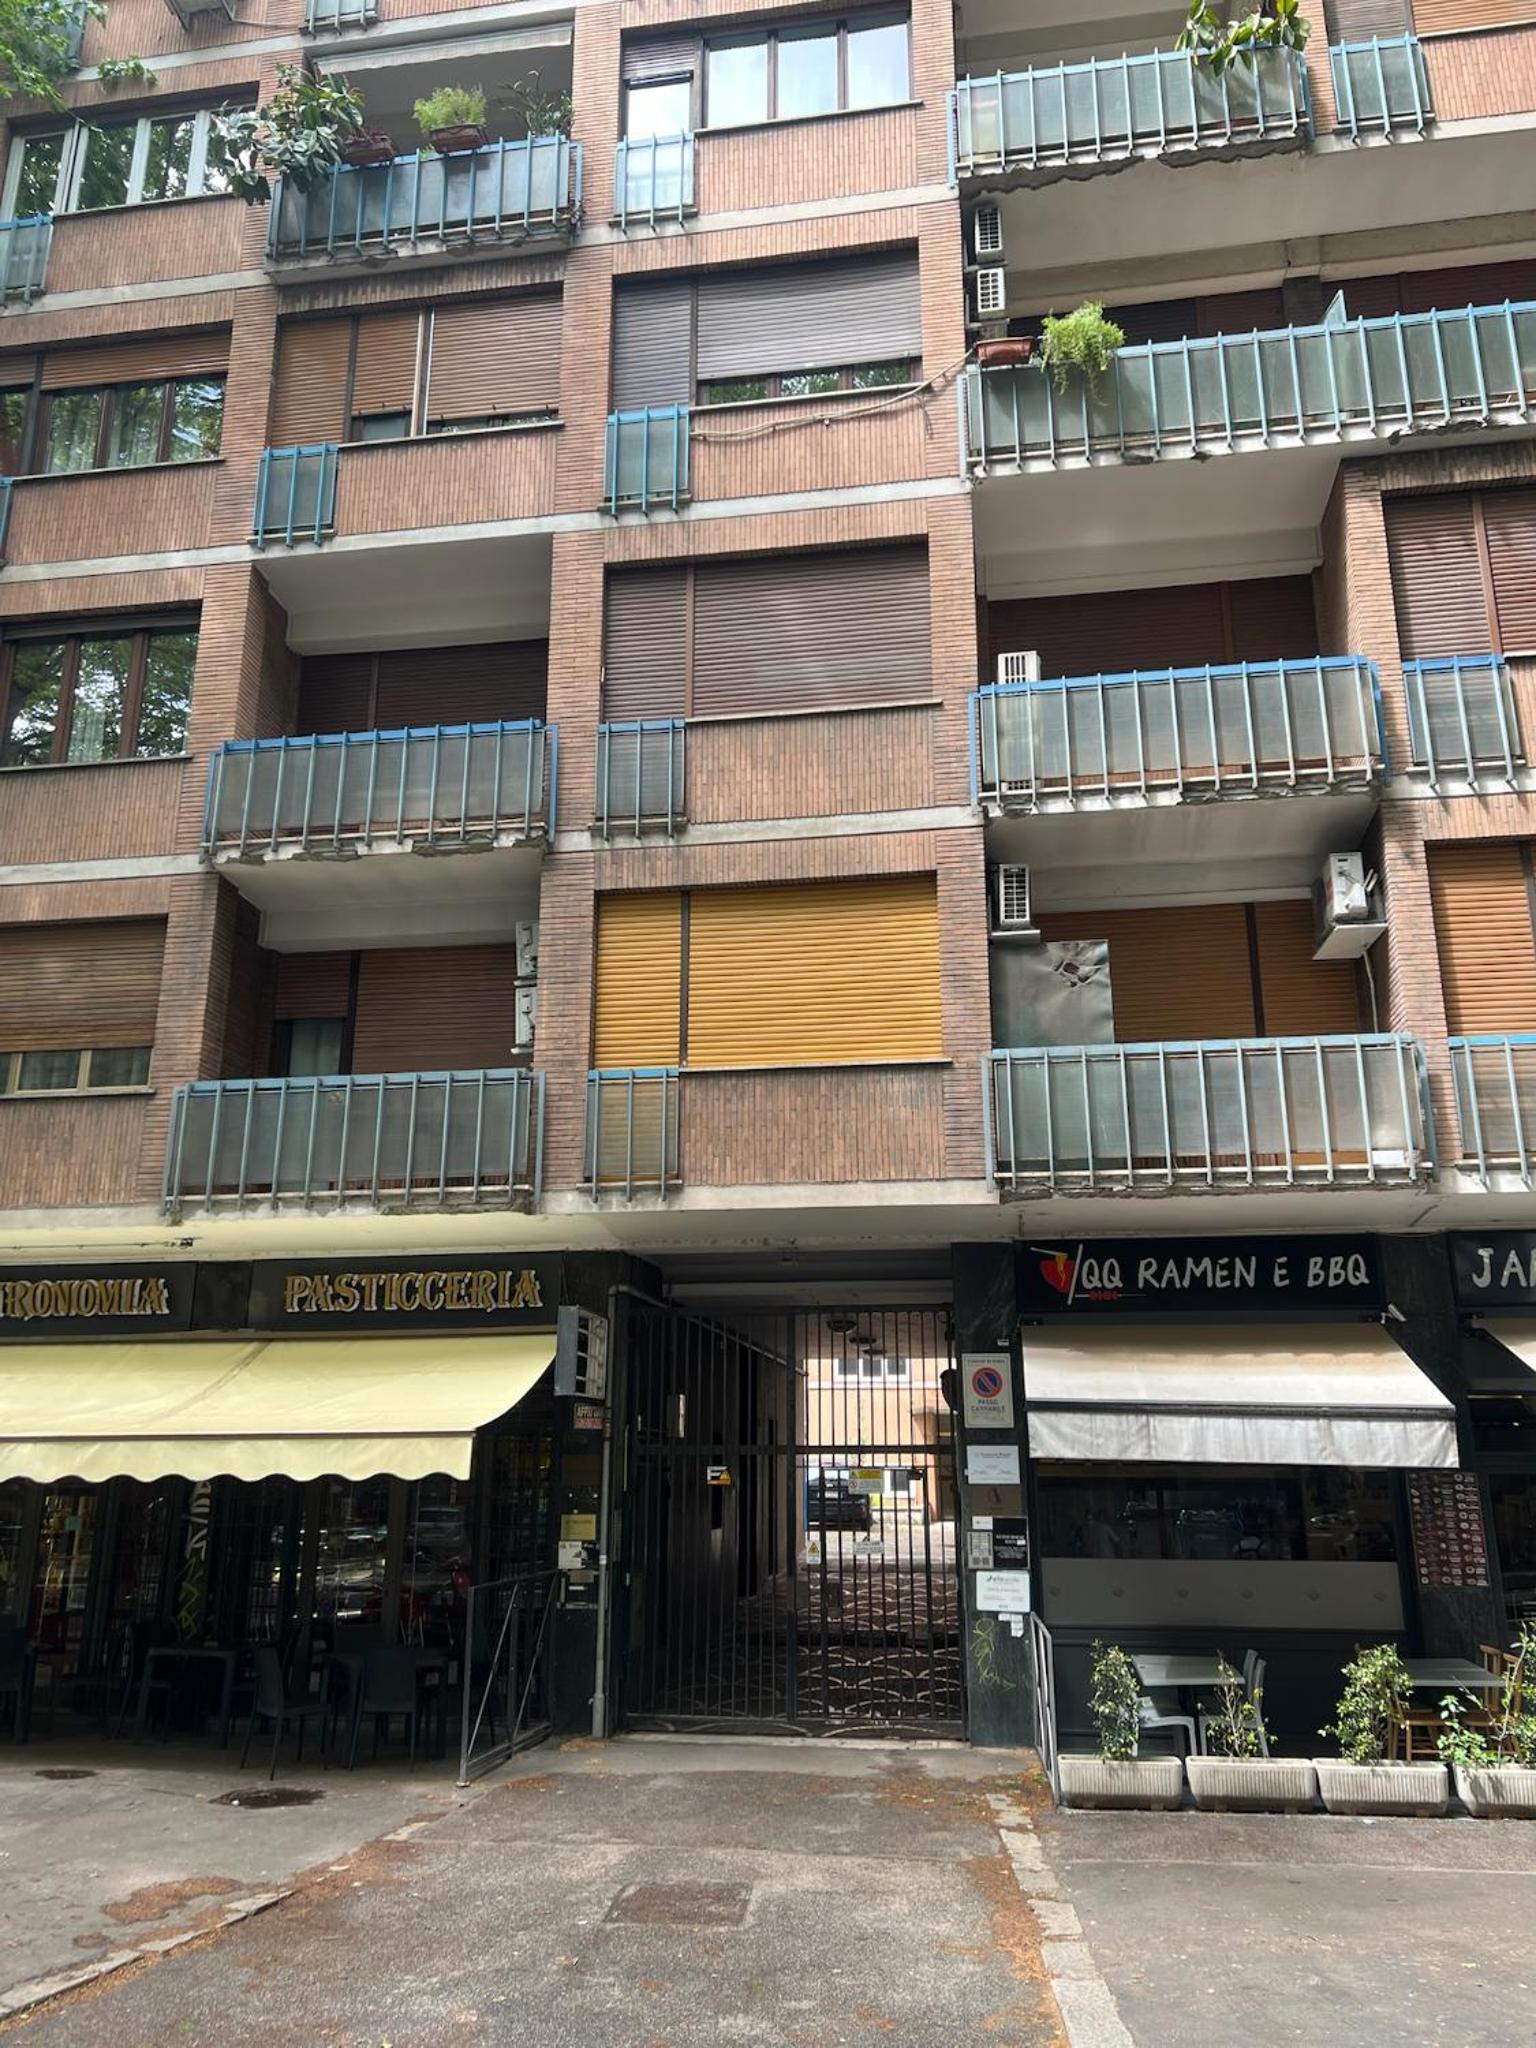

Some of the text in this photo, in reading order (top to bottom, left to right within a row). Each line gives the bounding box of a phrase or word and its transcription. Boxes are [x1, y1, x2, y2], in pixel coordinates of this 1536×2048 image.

[283, 1269, 544, 1313] PASTICCERIA
[1081, 1253, 1371, 1290] QQ RAMEN E BBQ
